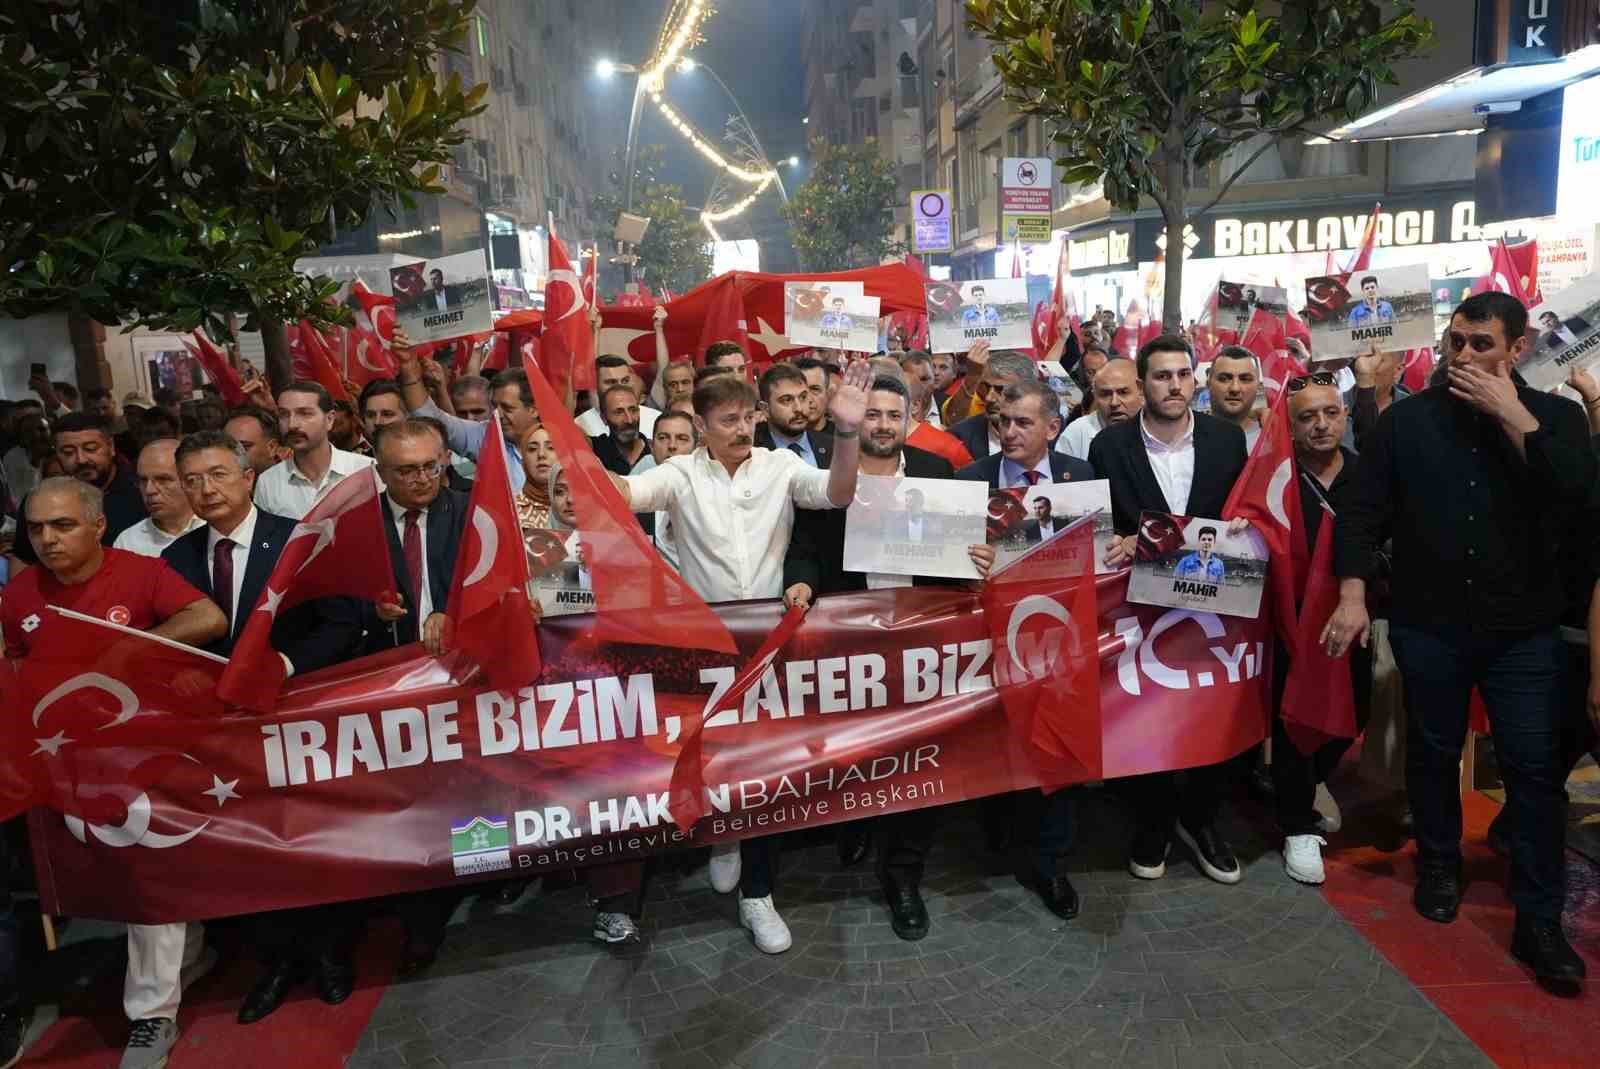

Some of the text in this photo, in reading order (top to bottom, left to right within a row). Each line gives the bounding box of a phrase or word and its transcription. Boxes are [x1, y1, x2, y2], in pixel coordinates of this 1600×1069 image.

[1214, 209, 1435, 257] BAKLAVACI
[423, 310, 465, 328] MEHMET
[883, 543, 943, 559] MEHMET
[556, 591, 596, 604] MEHM
[699, 653, 888, 728] ZAFER
[514, 806, 582, 846] DR.
[738, 744, 941, 809] BAHADIR
[712, 798, 829, 835] Belediye
[843, 779, 945, 811] Başkanı
